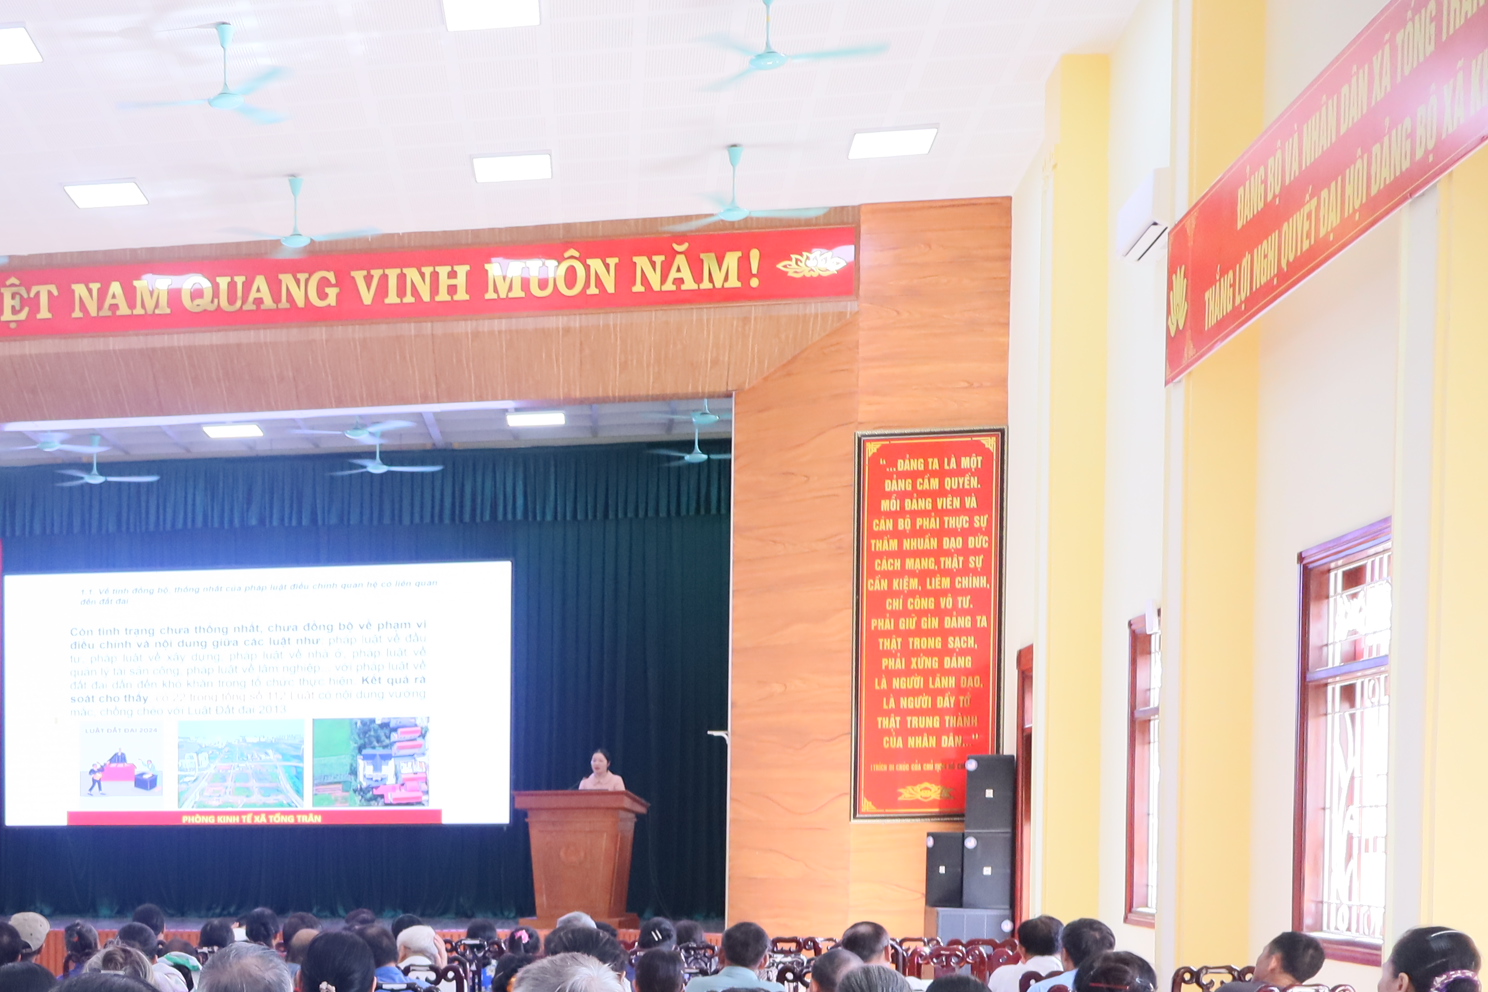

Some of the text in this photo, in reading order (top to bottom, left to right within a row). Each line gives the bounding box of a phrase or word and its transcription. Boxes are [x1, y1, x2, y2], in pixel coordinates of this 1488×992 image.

[1205, 265, 1234, 331] THẮNG
[1235, 251, 1251, 311] LỢI
[1253, 229, 1278, 292] NGHỊ
[1280, 185, 1317, 272] QUYẾT
[1319, 175, 1342, 241] ĐẠI
[1344, 147, 1368, 220] HỘI
[1371, 116, 1412, 198] ĐẢNG
[1415, 82, 1438, 163] BỘ
[1441, 57, 1464, 140] XÃ
[1237, 165, 1264, 230] ĐẢNG
[1267, 139, 1282, 205] BỘ
[1285, 123, 1299, 186] VÀ
[1303, 94, 1337, 170] NHÂN
[1340, 64, 1368, 137] DÂN
[1372, 31, 1391, 107] XÃ
[71, 277, 170, 319] NAM
[181, 268, 341, 313] QUANG
[351, 263, 470, 306] VINH
[484, 251, 618, 299] MUÔN
